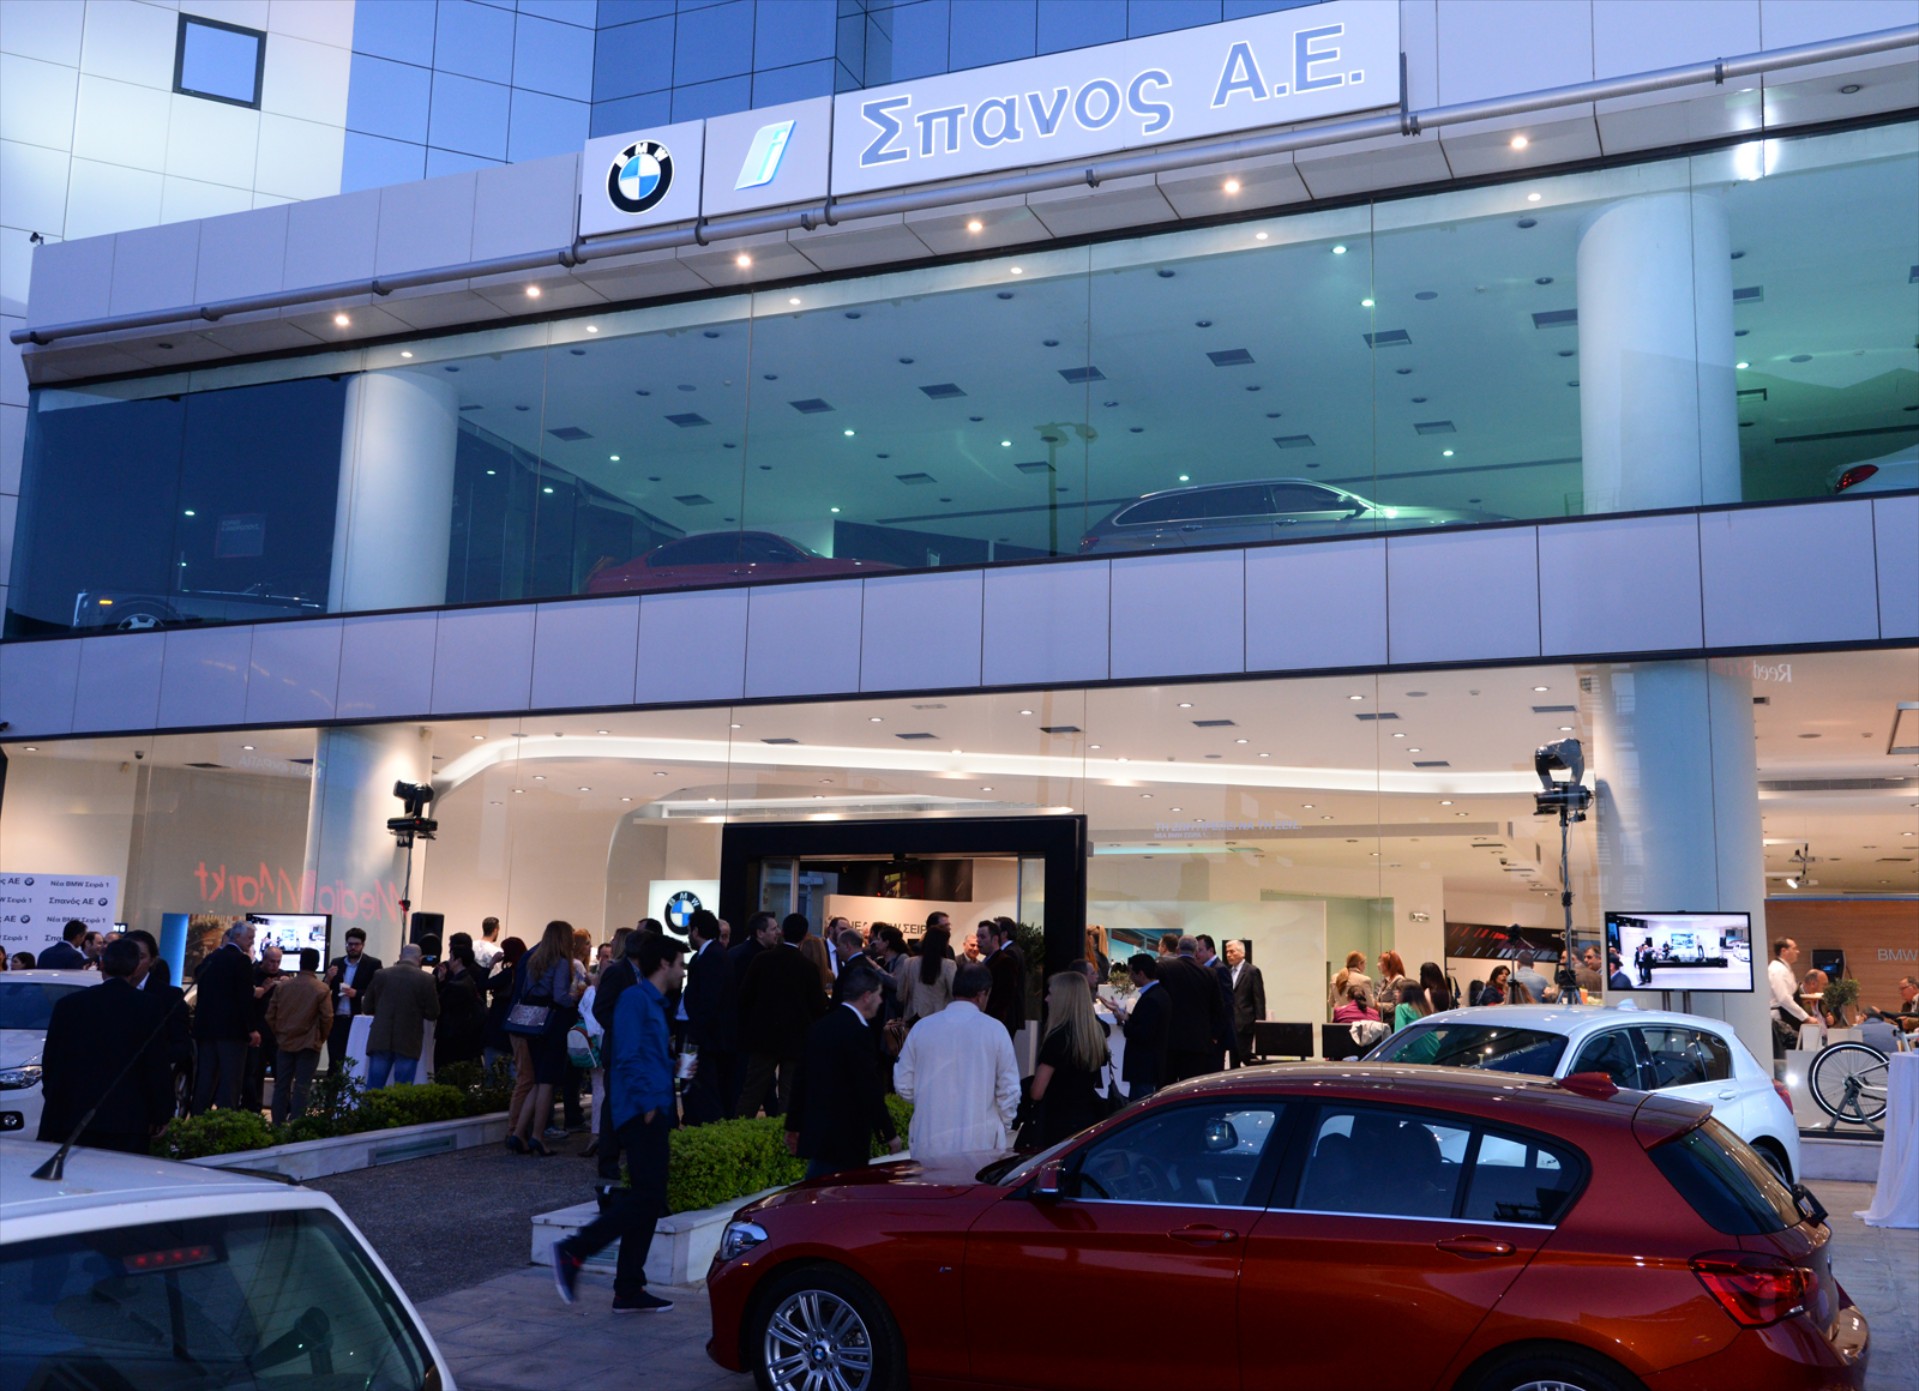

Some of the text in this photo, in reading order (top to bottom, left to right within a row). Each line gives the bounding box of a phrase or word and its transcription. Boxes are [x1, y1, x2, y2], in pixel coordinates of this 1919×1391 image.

[859, 67, 1174, 168] Σπανος
[48, 897, 80, 906] Σπανός
[1877, 949, 1919, 961] BMW
